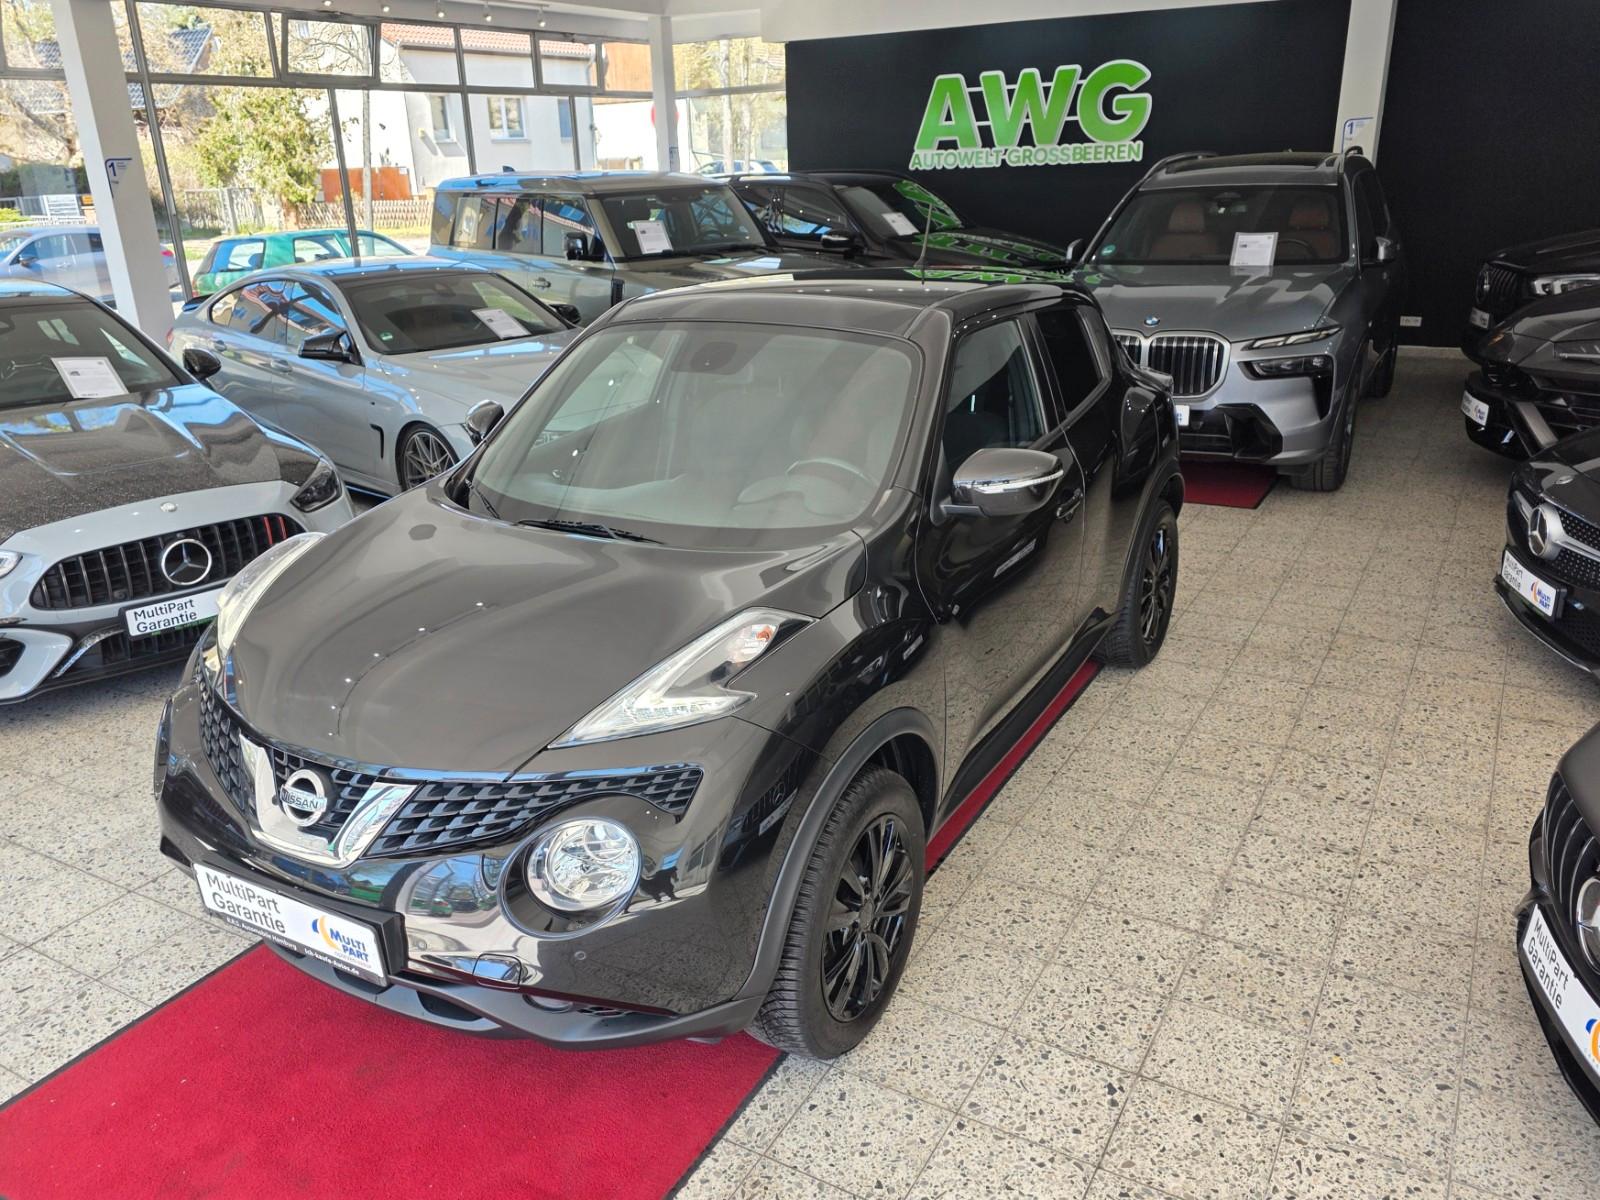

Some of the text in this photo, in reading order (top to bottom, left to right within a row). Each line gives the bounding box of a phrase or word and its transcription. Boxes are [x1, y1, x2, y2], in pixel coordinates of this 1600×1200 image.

[914, 60, 1152, 150] AWG
[911, 143, 1141, 169] AUTOWELT GROSSBEEREN
[133, 599, 195, 621] MultiPart
[136, 611, 197, 633] Garantie
[281, 788, 319, 809] NISSAN
[205, 871, 281, 914] MultiPart
[211, 891, 286, 934] Garantie
[341, 943, 369, 962] PART
[1534, 917, 1569, 991] MultiPart
[1528, 937, 1562, 1009] Garantie
